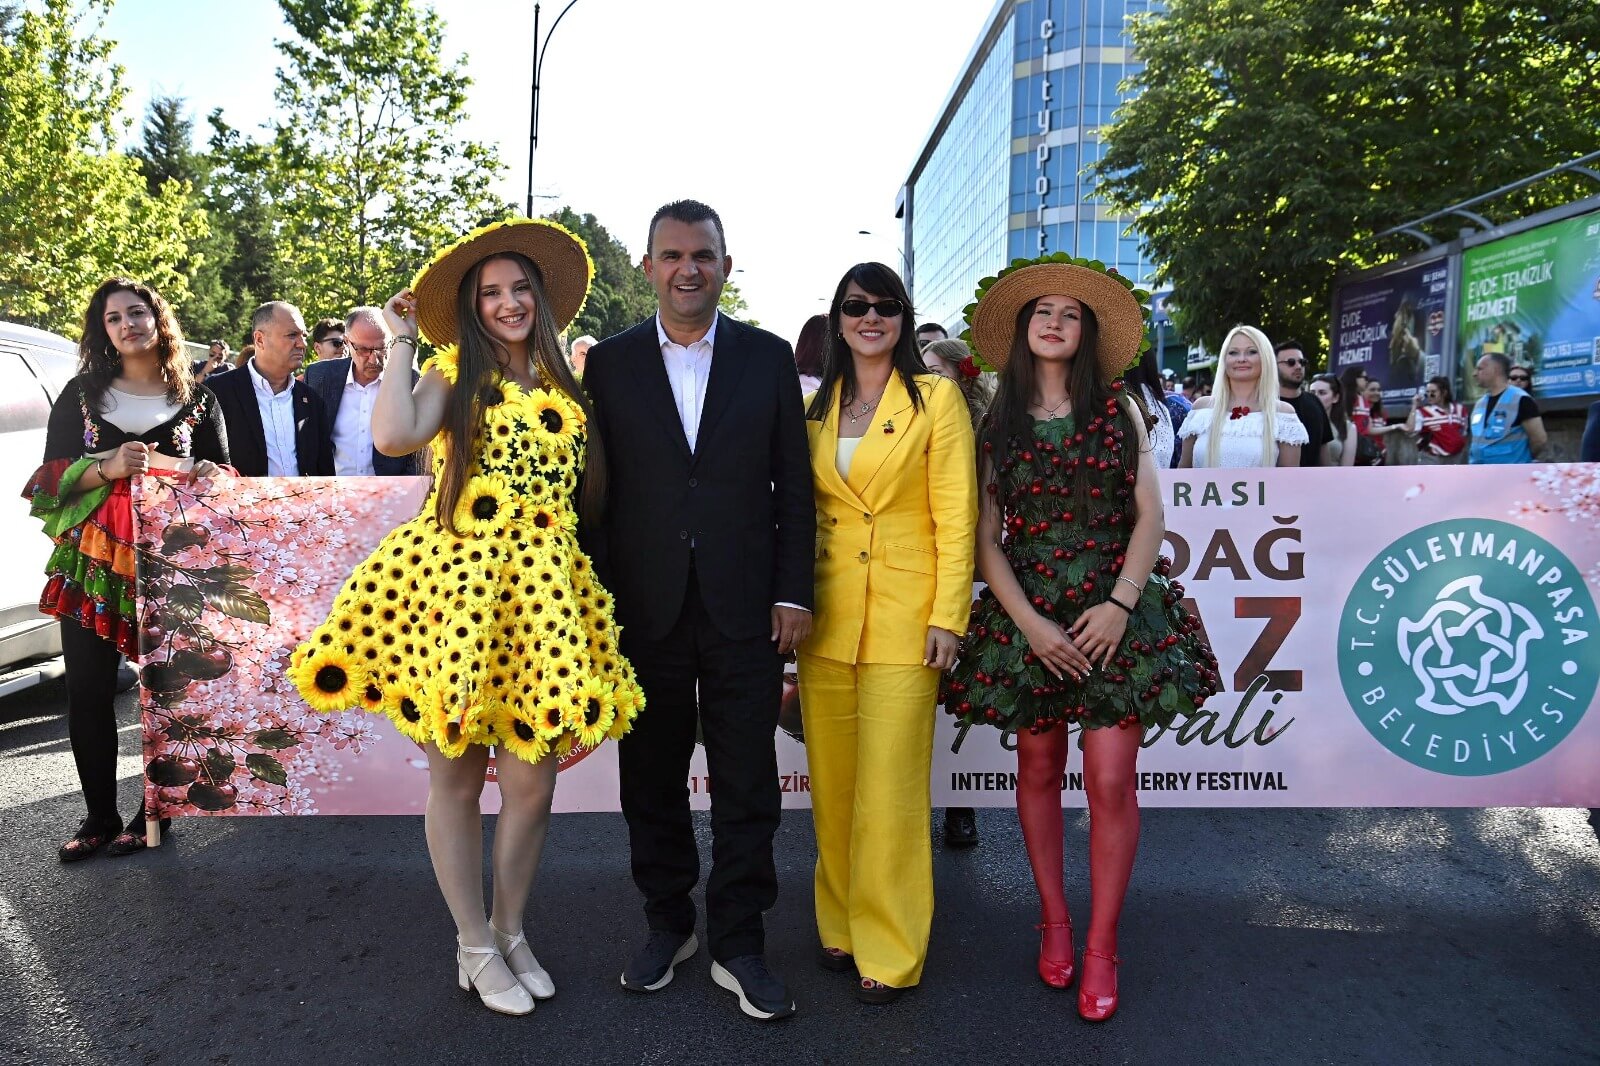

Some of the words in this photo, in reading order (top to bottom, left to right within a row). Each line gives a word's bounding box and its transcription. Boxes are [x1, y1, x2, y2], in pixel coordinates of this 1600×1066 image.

[1468, 276, 1498, 300] EVDE
[1502, 259, 1554, 291] TEMİZLİK
[1341, 310, 1362, 329] EVDE
[1466, 290, 1517, 322] HİZMETİ
[1340, 322, 1388, 347] KUAFÖRLÜK
[1338, 342, 1373, 366] HİZMETİ
[1173, 481, 1266, 506] RASI
[1162, 515, 1306, 581] DAĞ
[1351, 603, 1385, 650] T.C.
[1371, 531, 1589, 646] SÜLEYMANPAŞA
[1362, 685, 1577, 763] BELEDİYESİ
[1136, 772, 1191, 791] ERRY
[1196, 772, 1288, 791] FESTIVAL
